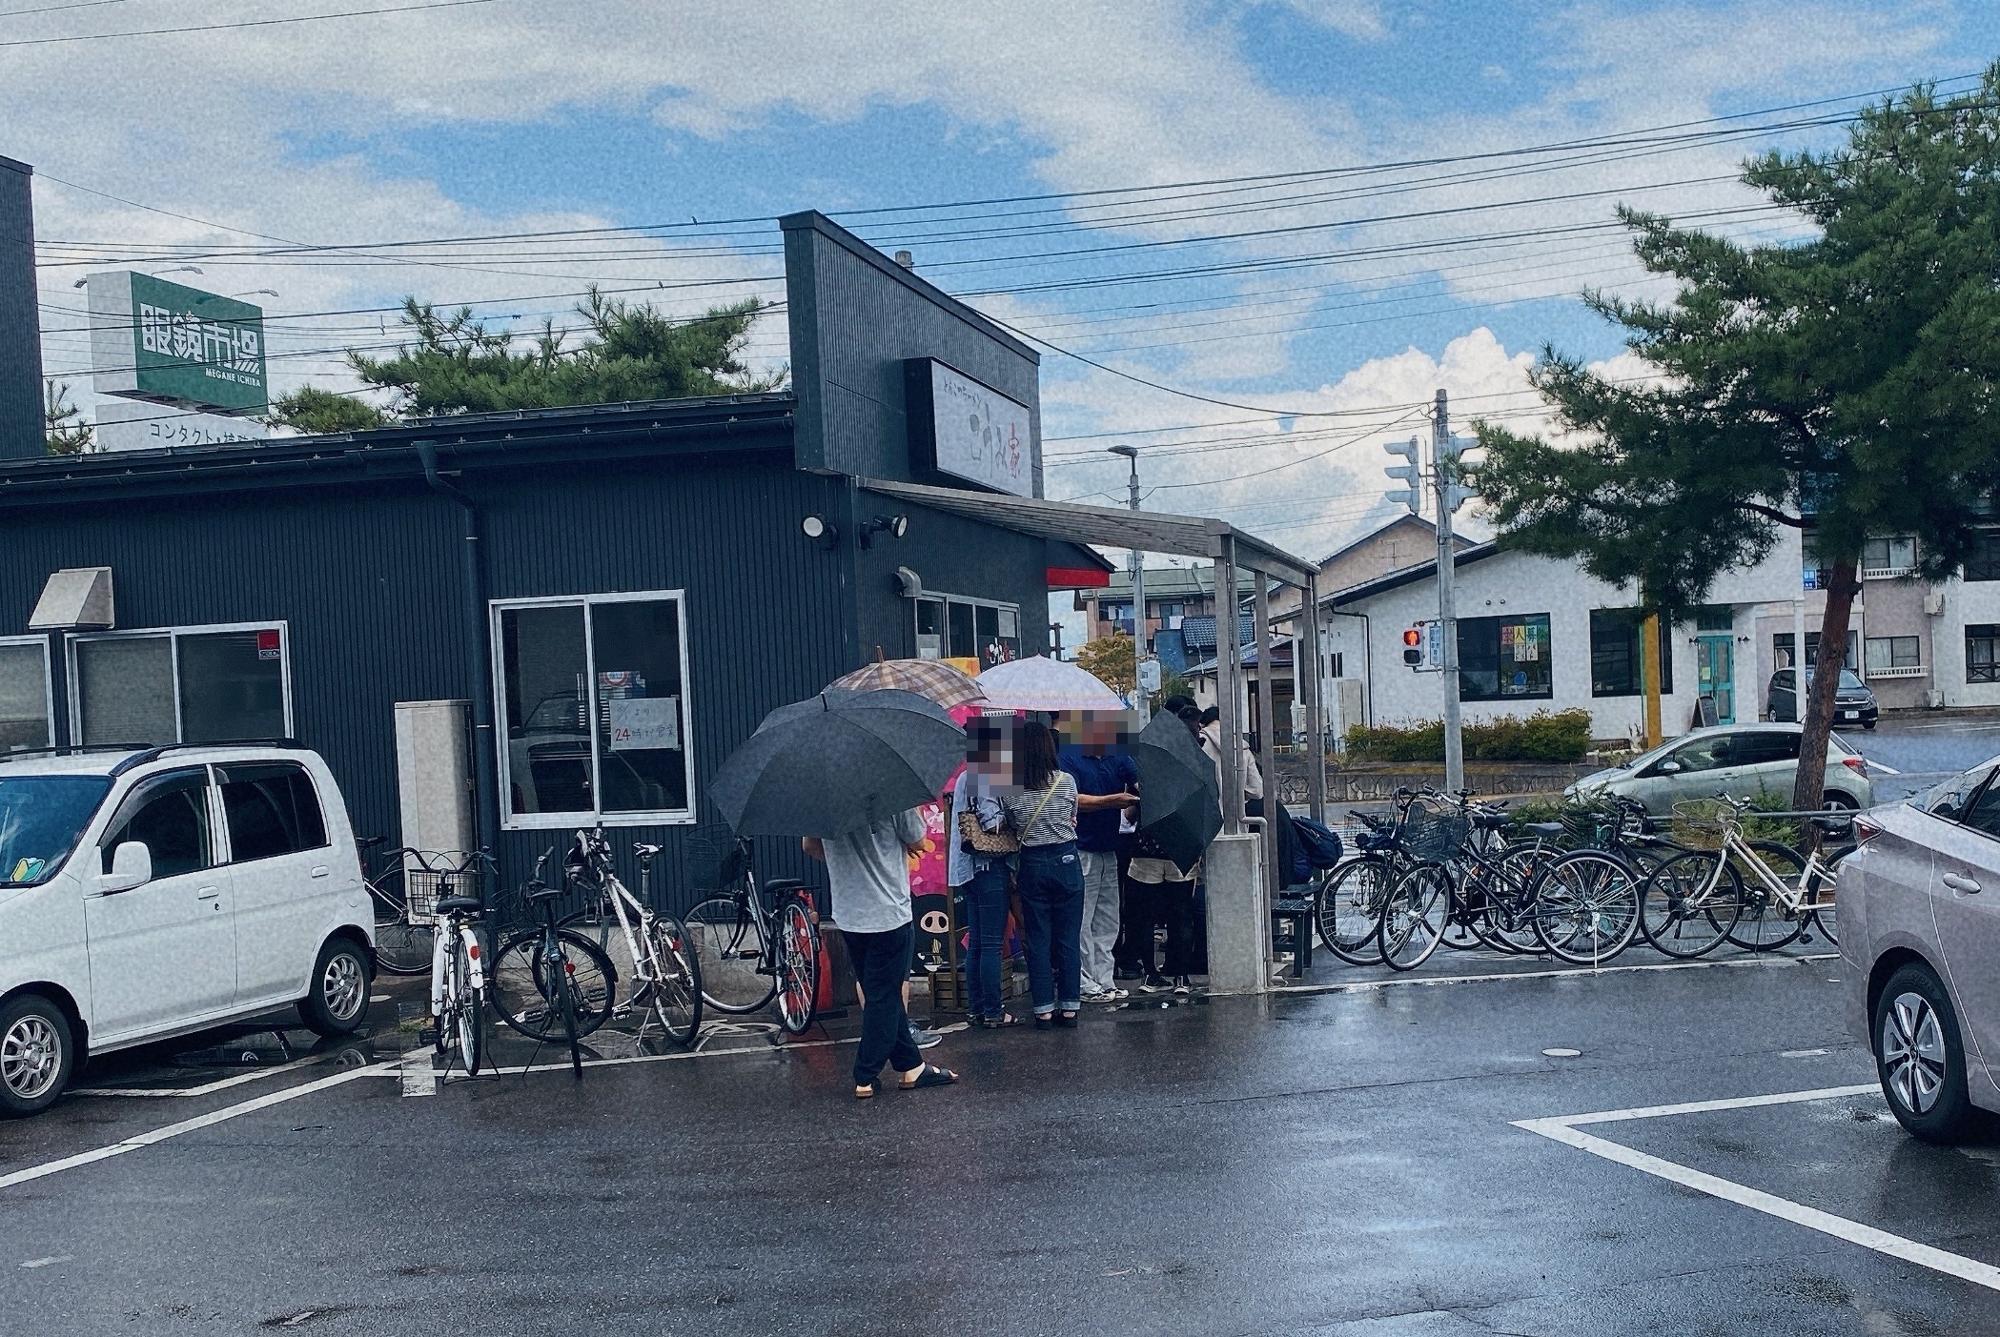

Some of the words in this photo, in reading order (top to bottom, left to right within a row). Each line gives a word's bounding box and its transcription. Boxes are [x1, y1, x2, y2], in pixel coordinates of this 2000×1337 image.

[140, 303, 260, 375] 眼鏡市場
[205, 368, 236, 382] MEGANE
[237, 375, 261, 387] ICHIBA
